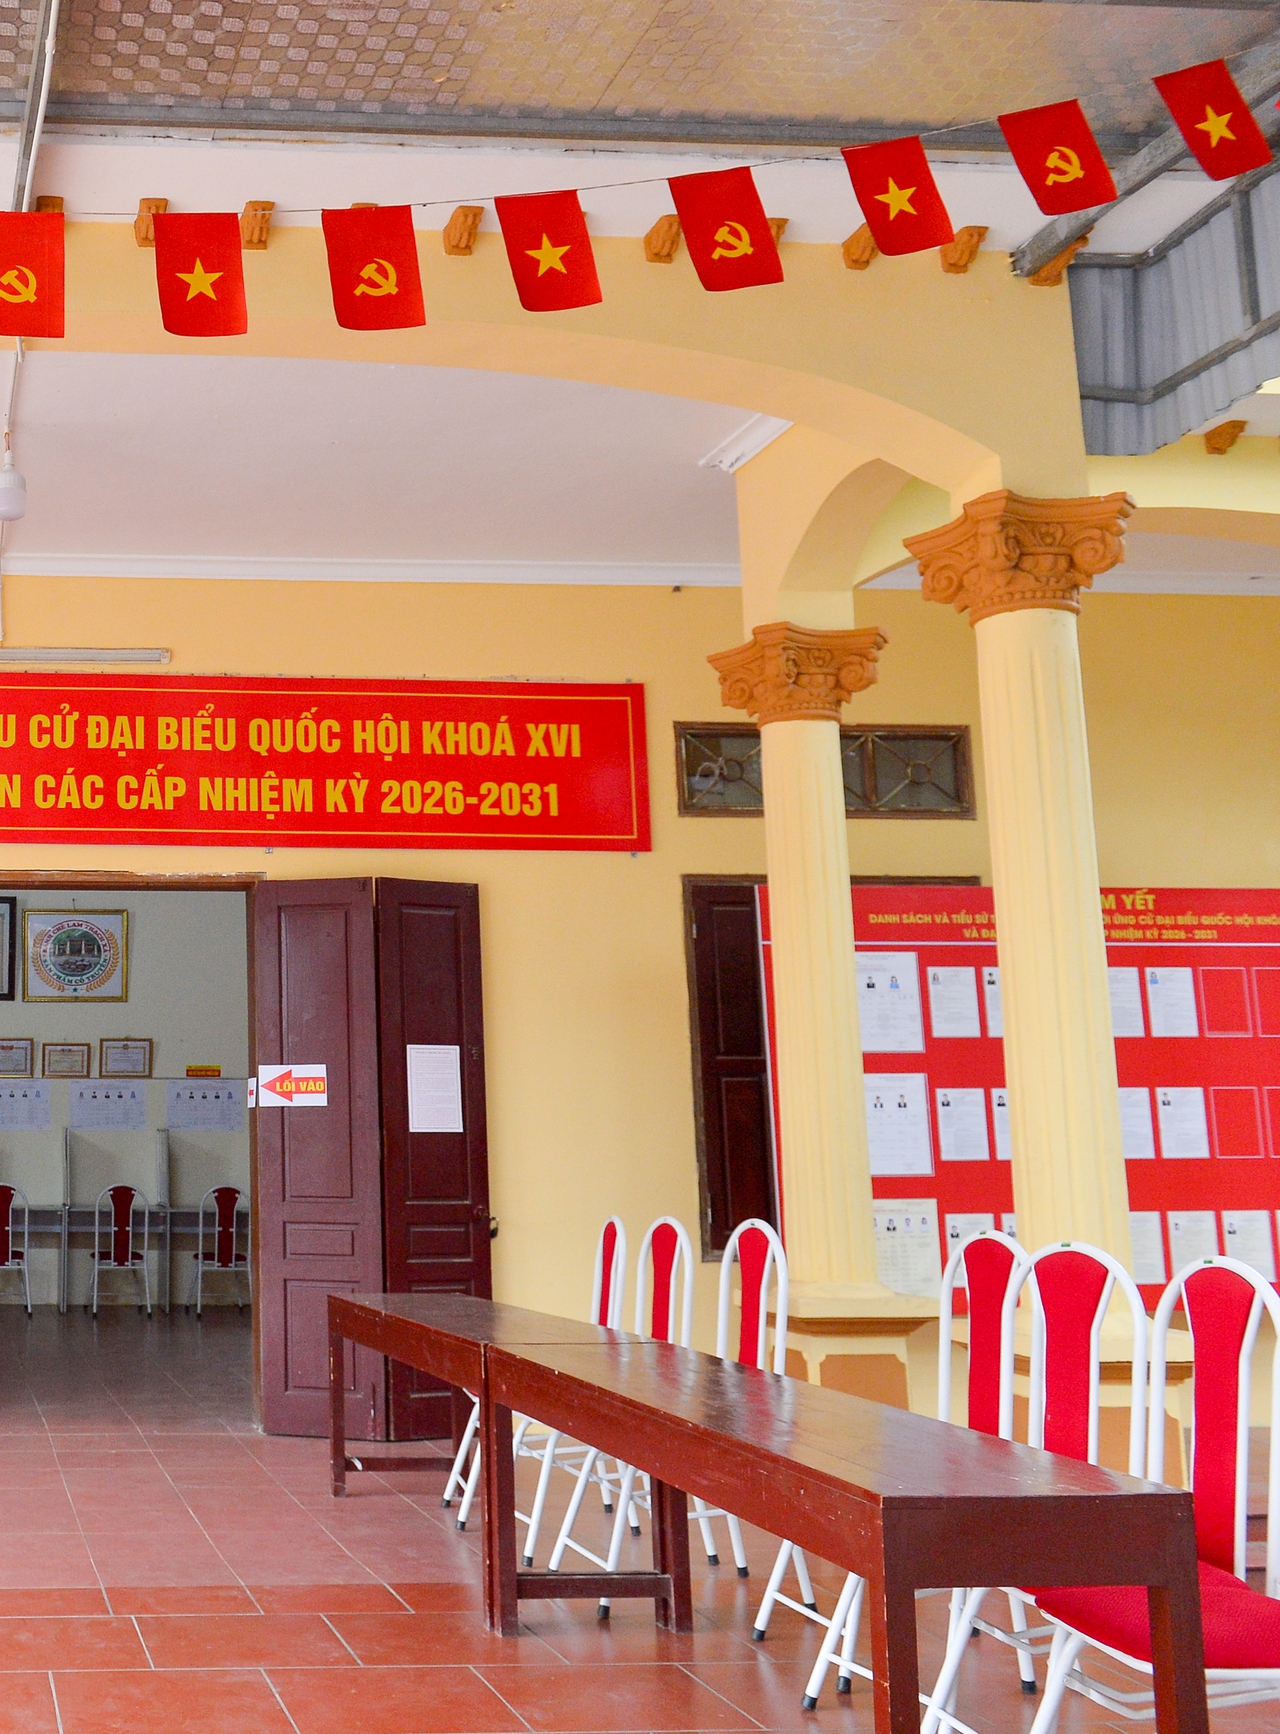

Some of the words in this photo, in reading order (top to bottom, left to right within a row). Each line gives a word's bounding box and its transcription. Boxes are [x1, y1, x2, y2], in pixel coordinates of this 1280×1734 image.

[30, 703, 78, 748] CỬ
[87, 714, 144, 757] ĐẠI
[158, 704, 235, 751] BIỂU
[250, 708, 340, 755] QUỐC
[354, 714, 409, 760] HỘI
[423, 721, 514, 757] KHOÁ
[526, 722, 582, 758] XVI
[35, 767, 104, 809] CÁC
[117, 764, 186, 810] CẤP
[199, 771, 313, 820] NHIỆM
[326, 772, 368, 813] KỲ
[381, 780, 559, 817] 2026-2031
[1122, 889, 1156, 910] YẾT
[869, 914, 900, 923] DANH
[902, 912, 932, 923] SÁCH
[935, 913, 950, 923] VÀ
[964, 928, 979, 938] VÀ
[276, 1078, 295, 1092] LỐI
[299, 1079, 324, 1092] VÀO
